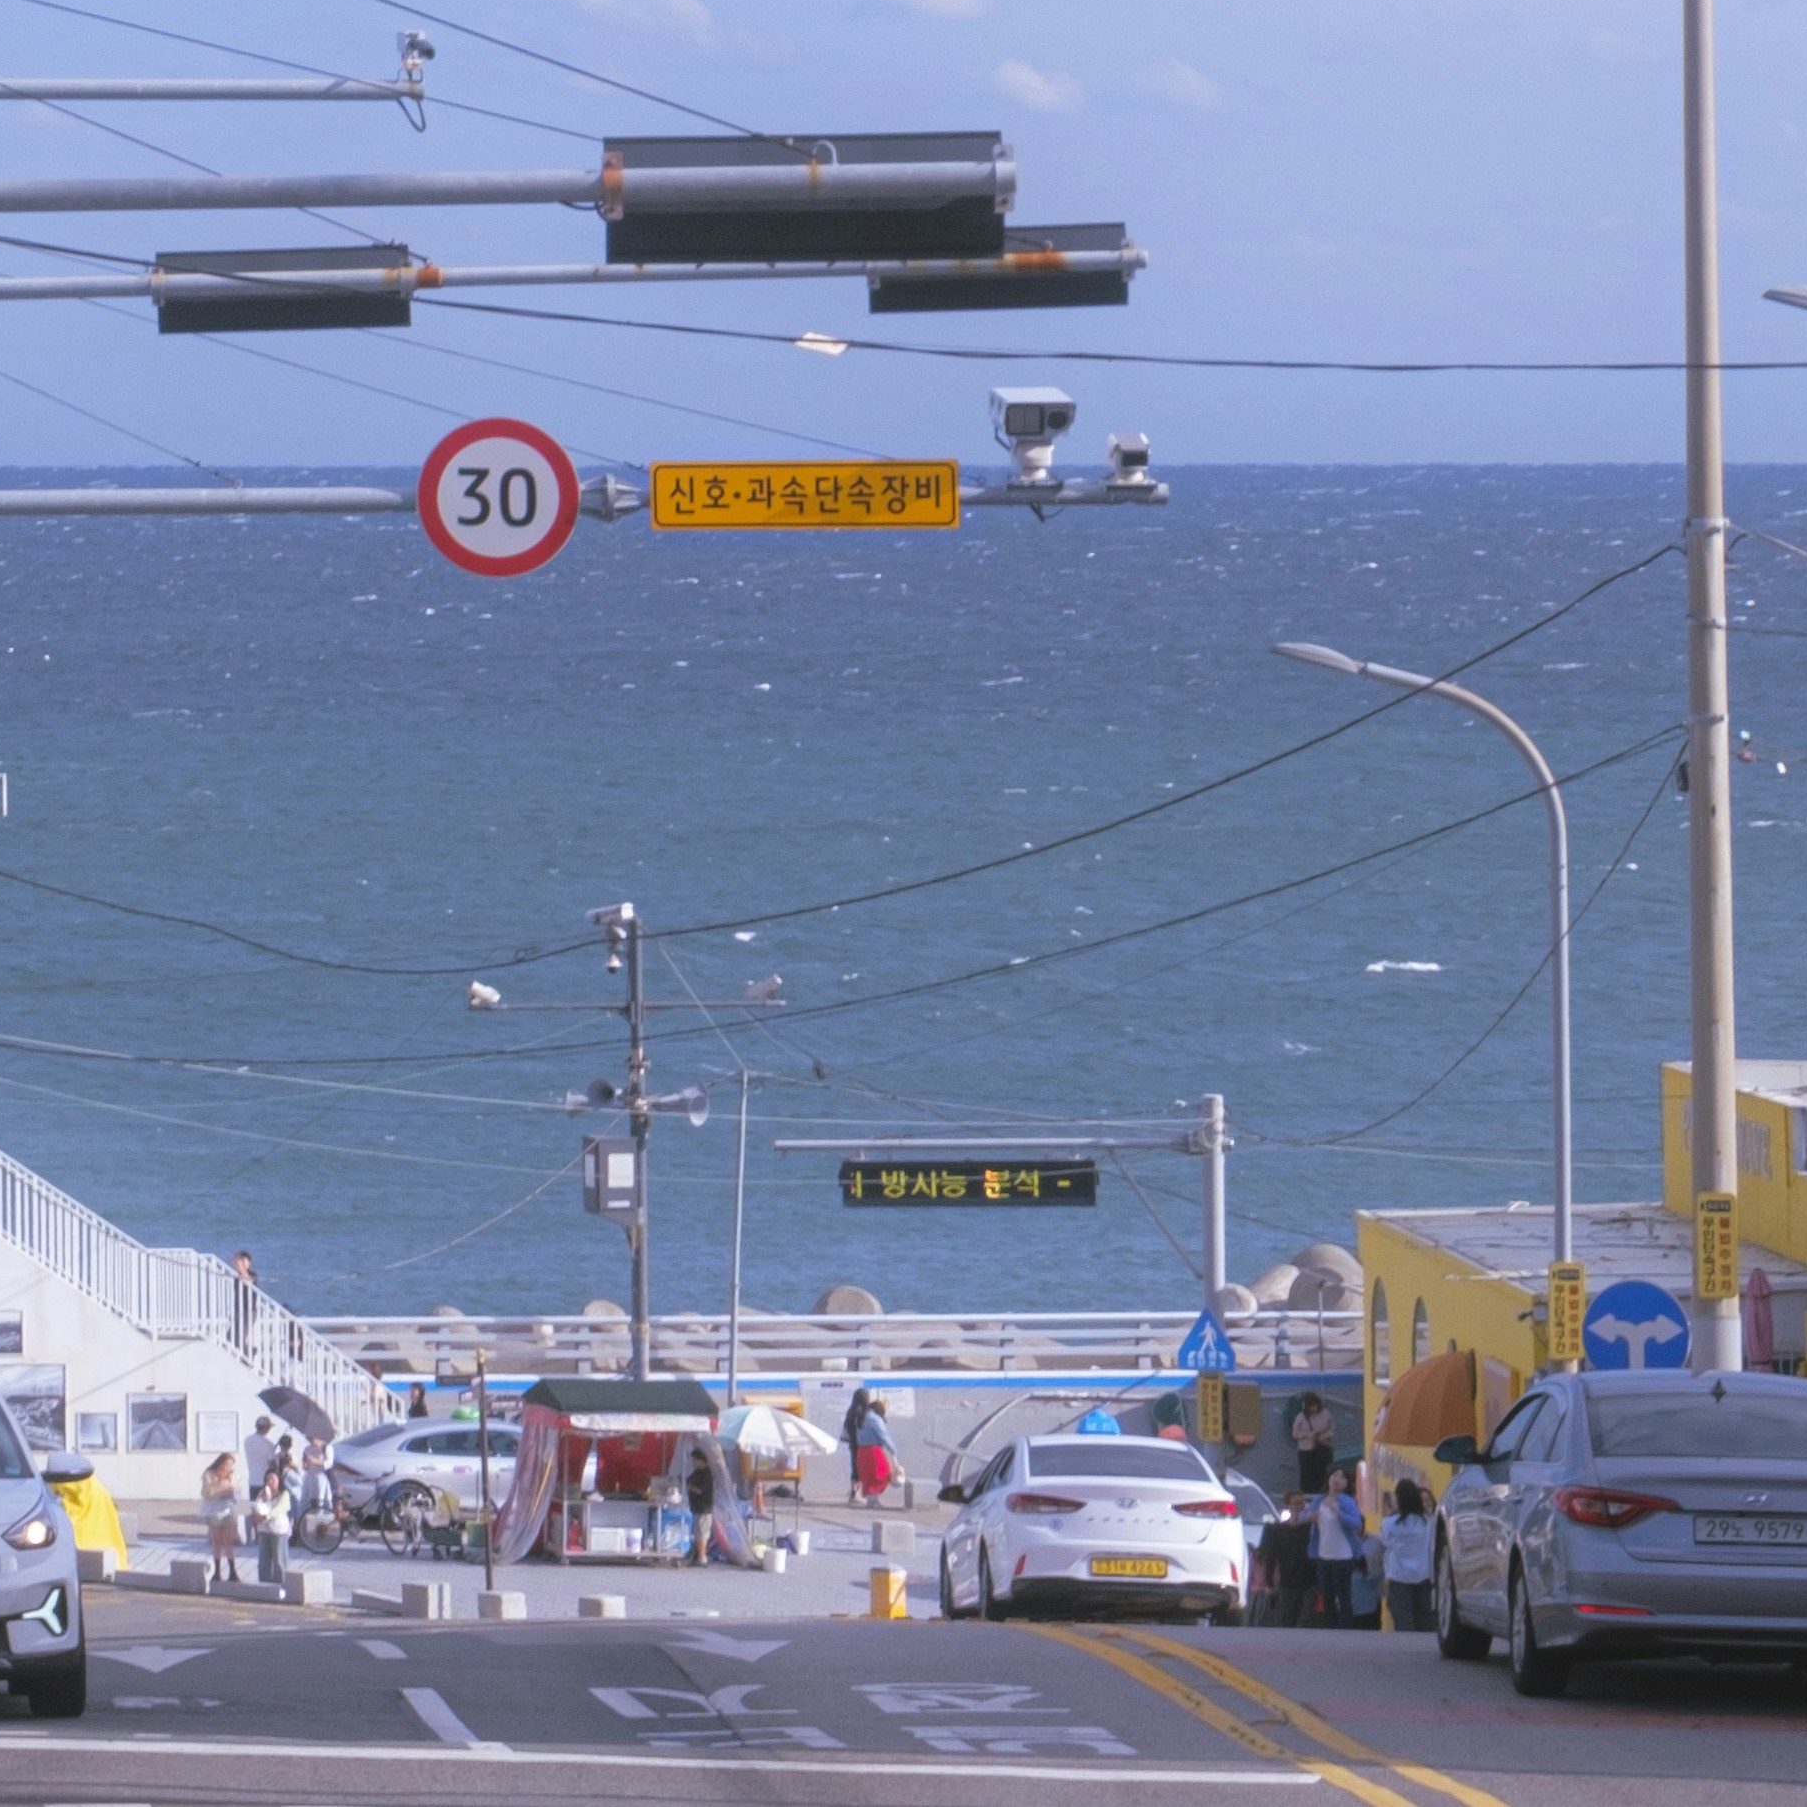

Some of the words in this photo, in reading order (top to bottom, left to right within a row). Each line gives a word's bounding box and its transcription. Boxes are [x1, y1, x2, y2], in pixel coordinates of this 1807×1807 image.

[456, 466, 539, 527] 30
[669, 474, 943, 515] 신호·과속단속장비
[881, 1169, 968, 1199] 방사능
[1753, 1520, 1804, 1540] 9579
